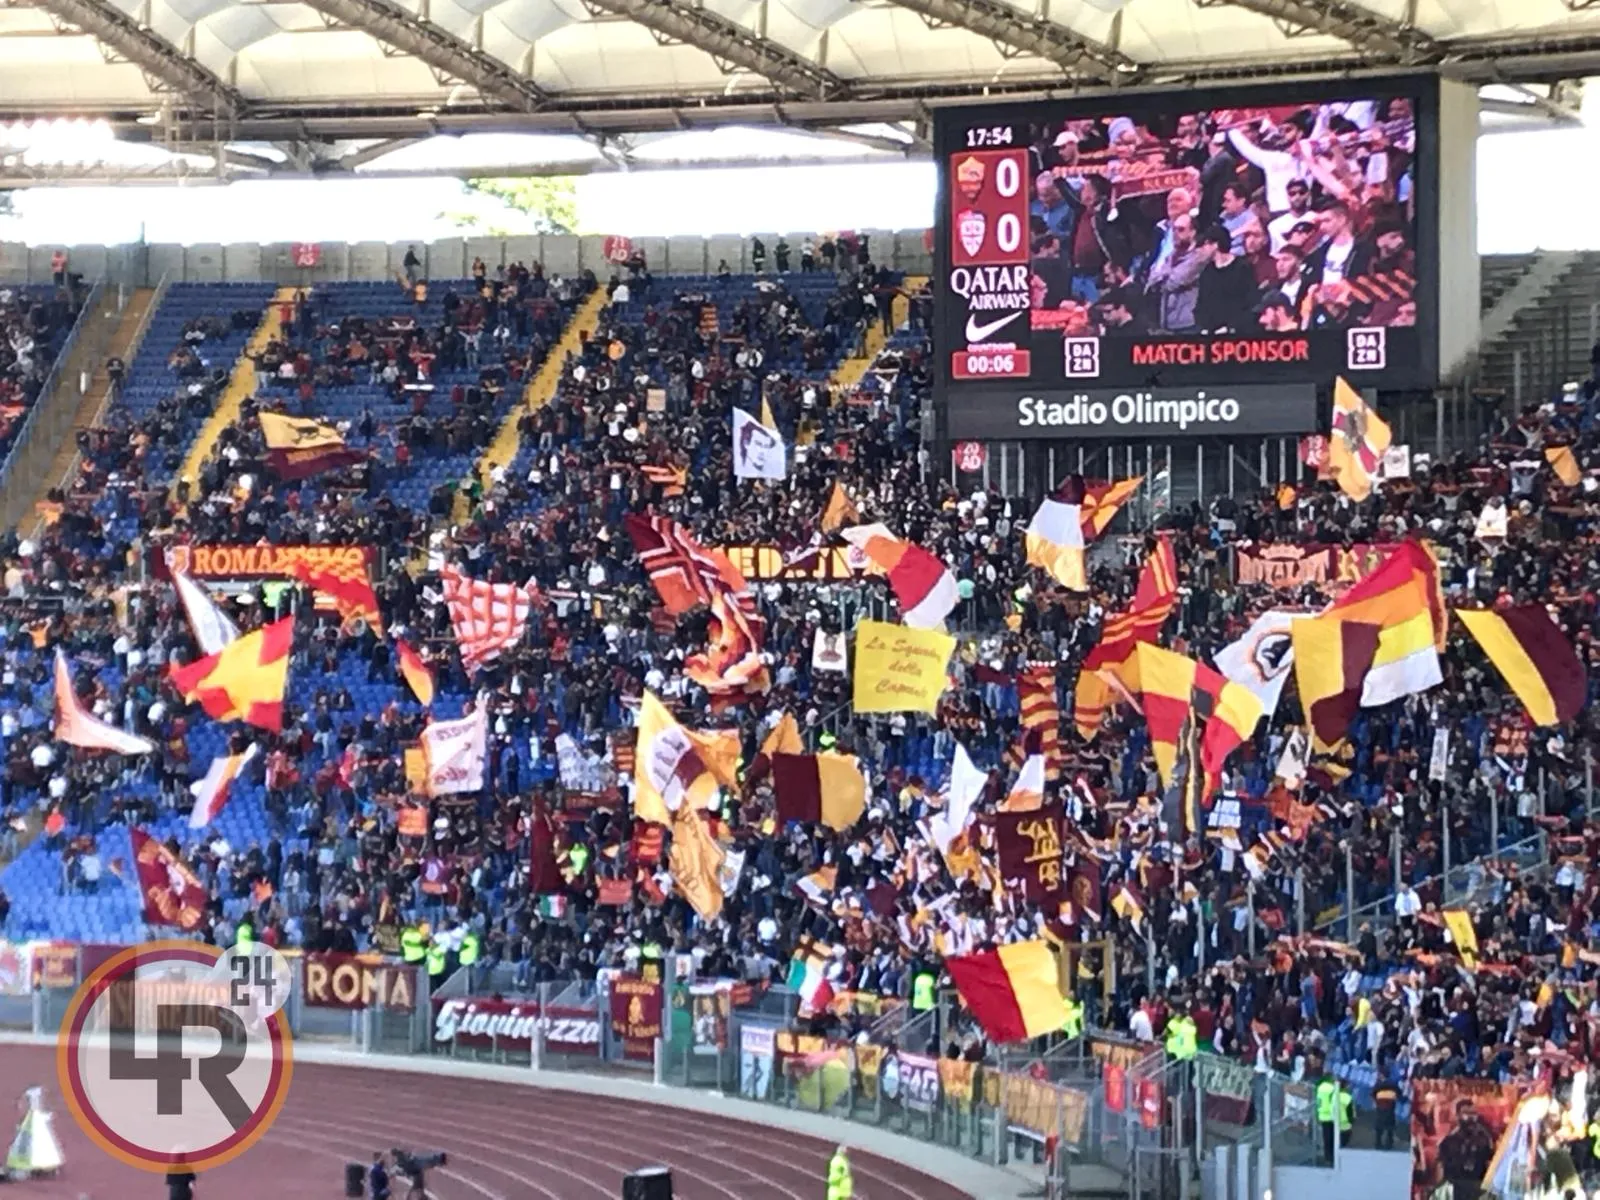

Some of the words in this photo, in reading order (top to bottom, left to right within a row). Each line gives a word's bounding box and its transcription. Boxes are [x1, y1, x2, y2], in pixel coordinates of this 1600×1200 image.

[966, 126, 1013, 147] 17:54
[996, 157, 1020, 198] 0
[997, 212, 1021, 253] 0
[950, 266, 1029, 299] QATAR
[968, 292, 1031, 311] AIRWAYS
[967, 354, 1015, 373] 00:06
[1132, 343, 1205, 365] MATCH
[1210, 339, 1310, 364] SPONSOR
[1018, 394, 1108, 426] Stadio
[1111, 391, 1240, 430] Olimpico
[307, 963, 412, 1007] ROMA
